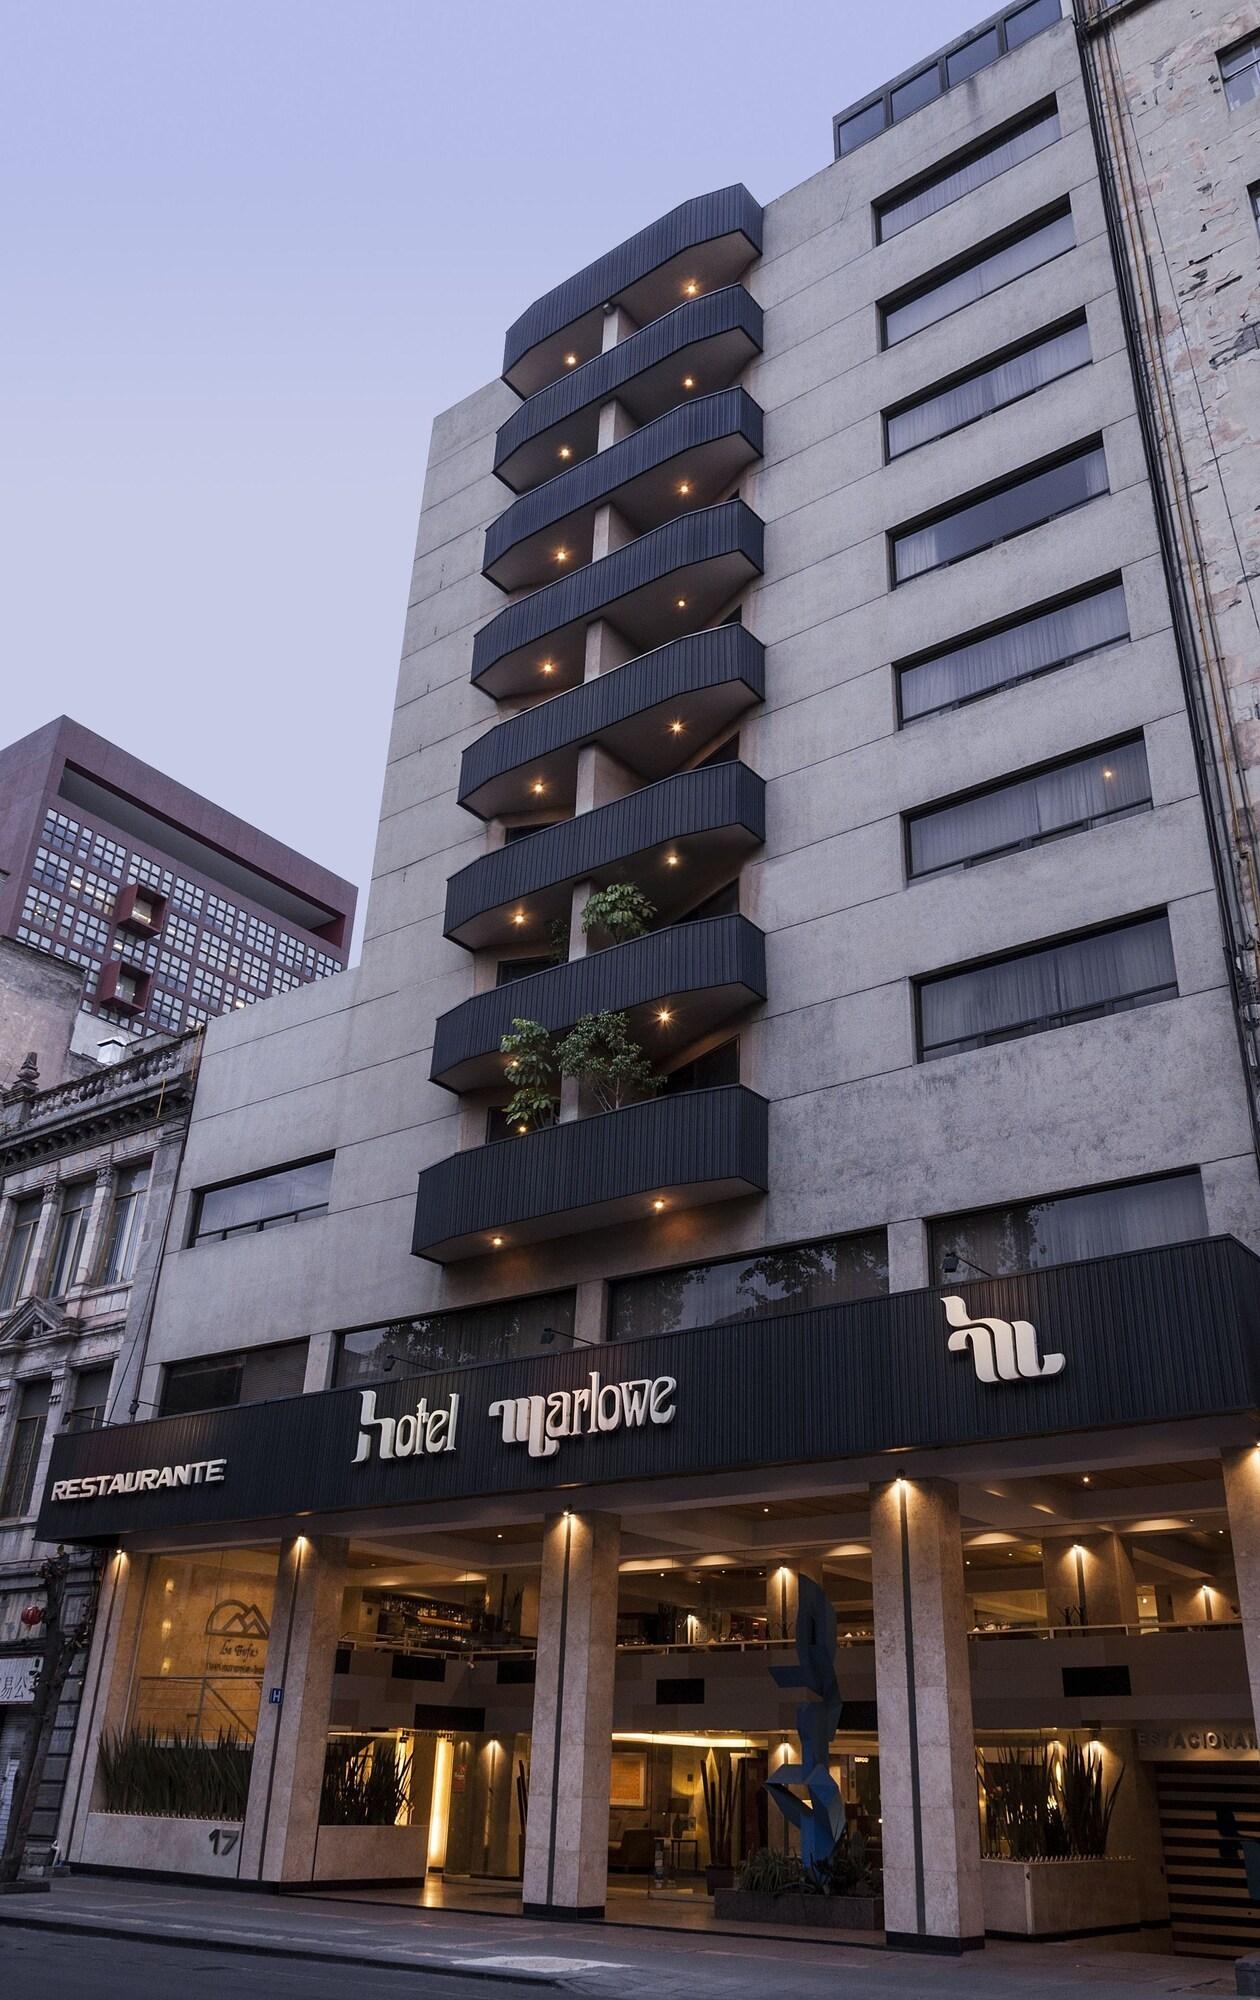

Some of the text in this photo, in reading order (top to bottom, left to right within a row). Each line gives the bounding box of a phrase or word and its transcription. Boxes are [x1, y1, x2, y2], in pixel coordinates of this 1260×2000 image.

[351, 1390, 460, 1463] hotel
[51, 1459, 227, 1501] RESTAURANTE
[272, 1689, 281, 1703] H
[209, 1829, 239, 1856] 17
